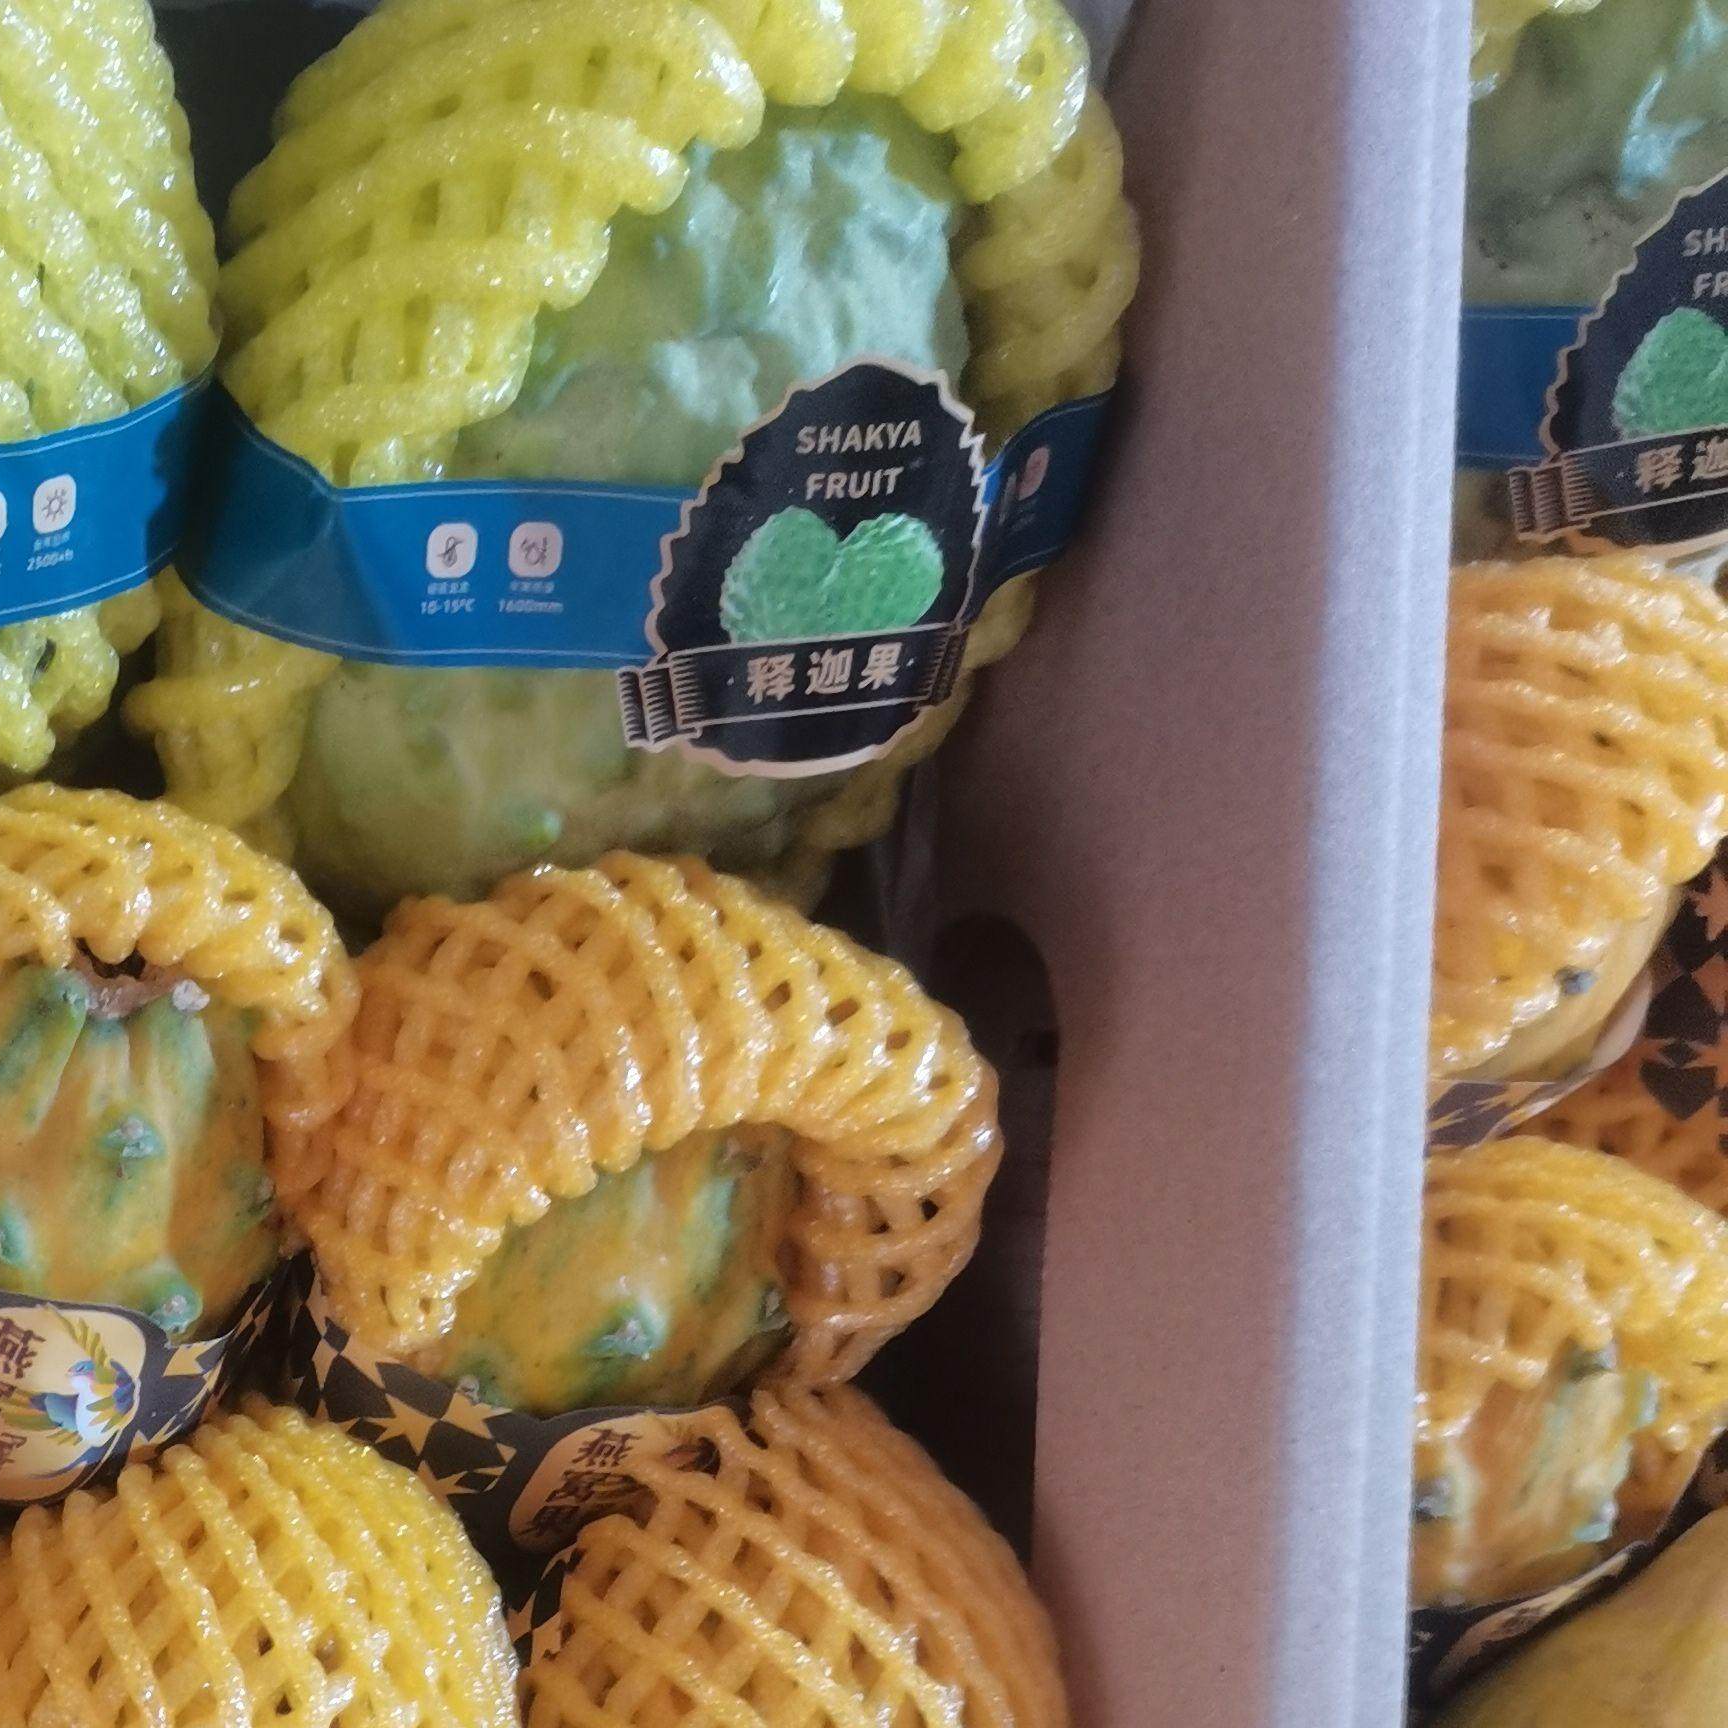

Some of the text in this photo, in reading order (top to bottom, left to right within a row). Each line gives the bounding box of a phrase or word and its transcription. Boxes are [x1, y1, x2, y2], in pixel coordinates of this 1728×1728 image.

[1682, 226, 1728, 258] SH
[794, 419, 923, 455] SHAKYA
[805, 465, 905, 501] FRUIT
[746, 641, 904, 705] 释迦果
